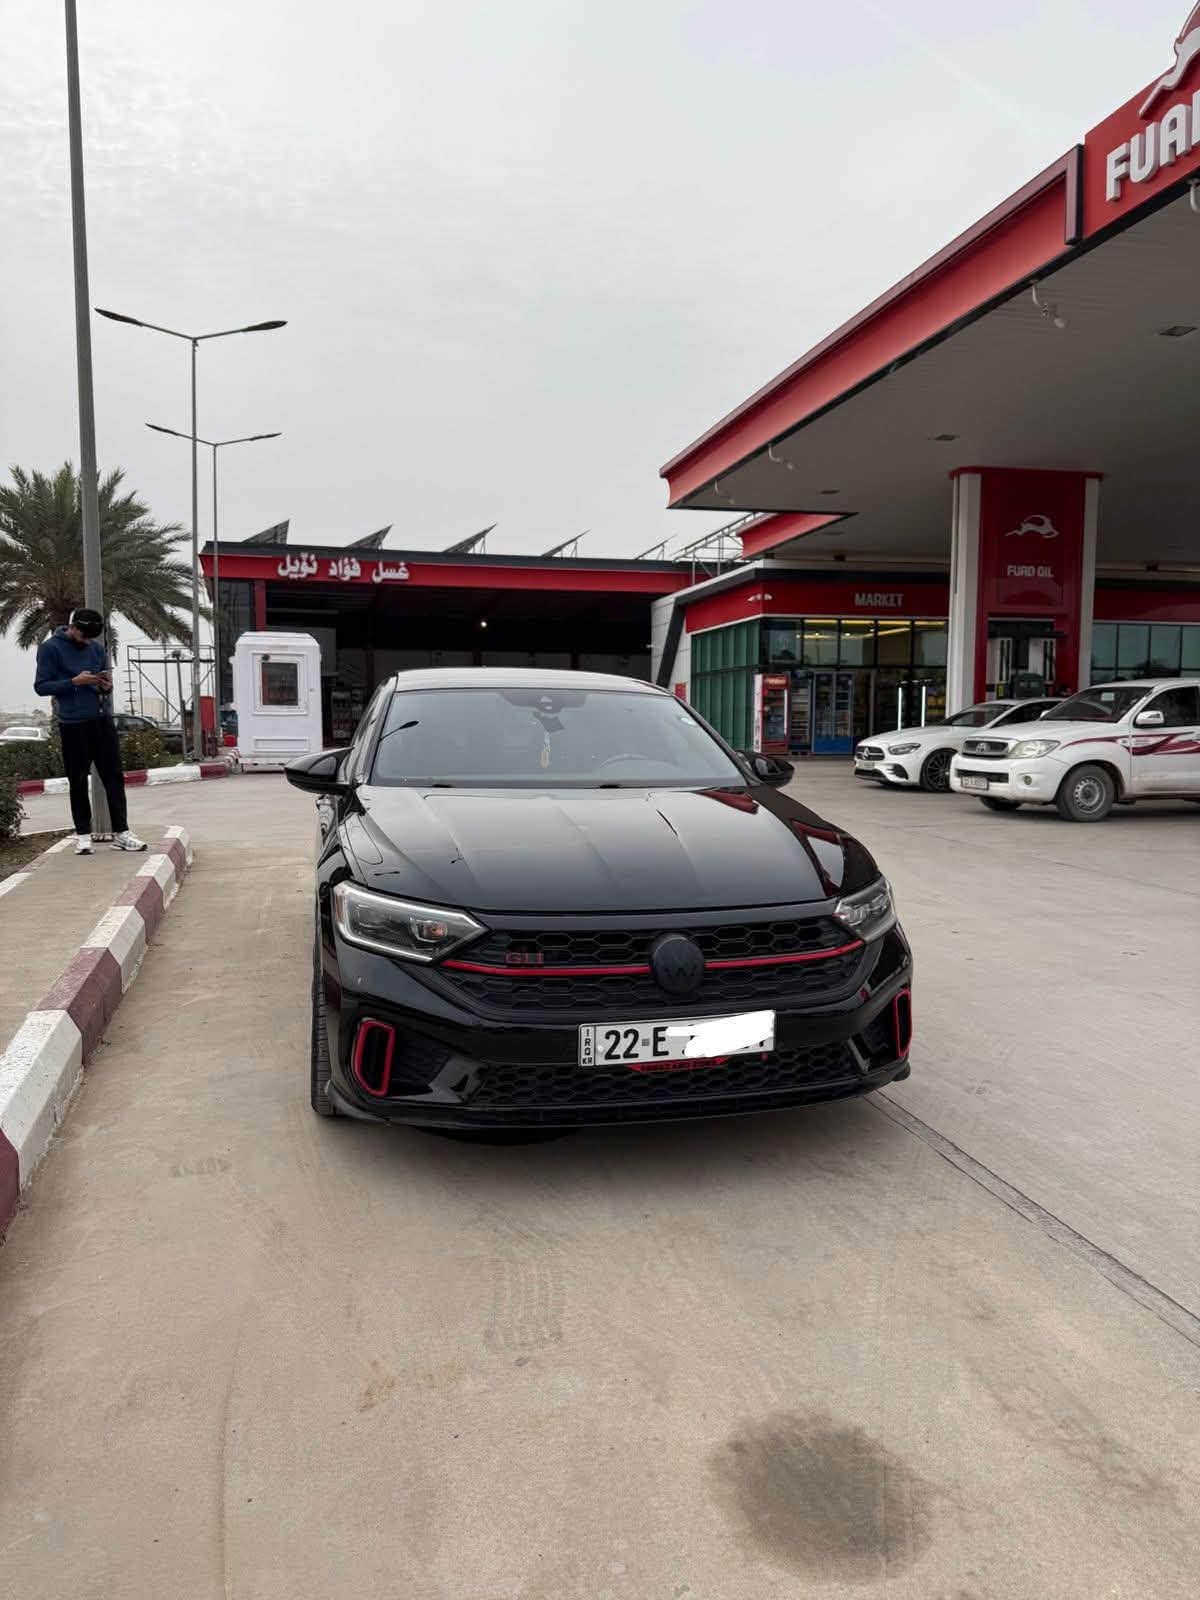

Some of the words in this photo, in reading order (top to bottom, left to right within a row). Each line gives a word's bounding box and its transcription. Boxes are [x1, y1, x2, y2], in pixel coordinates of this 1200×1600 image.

[1105, 90, 1200, 202] FUA
[372, 560, 410, 583] غسل
[1037, 566, 1055, 578] OIL
[855, 593, 904, 607] MARKET
